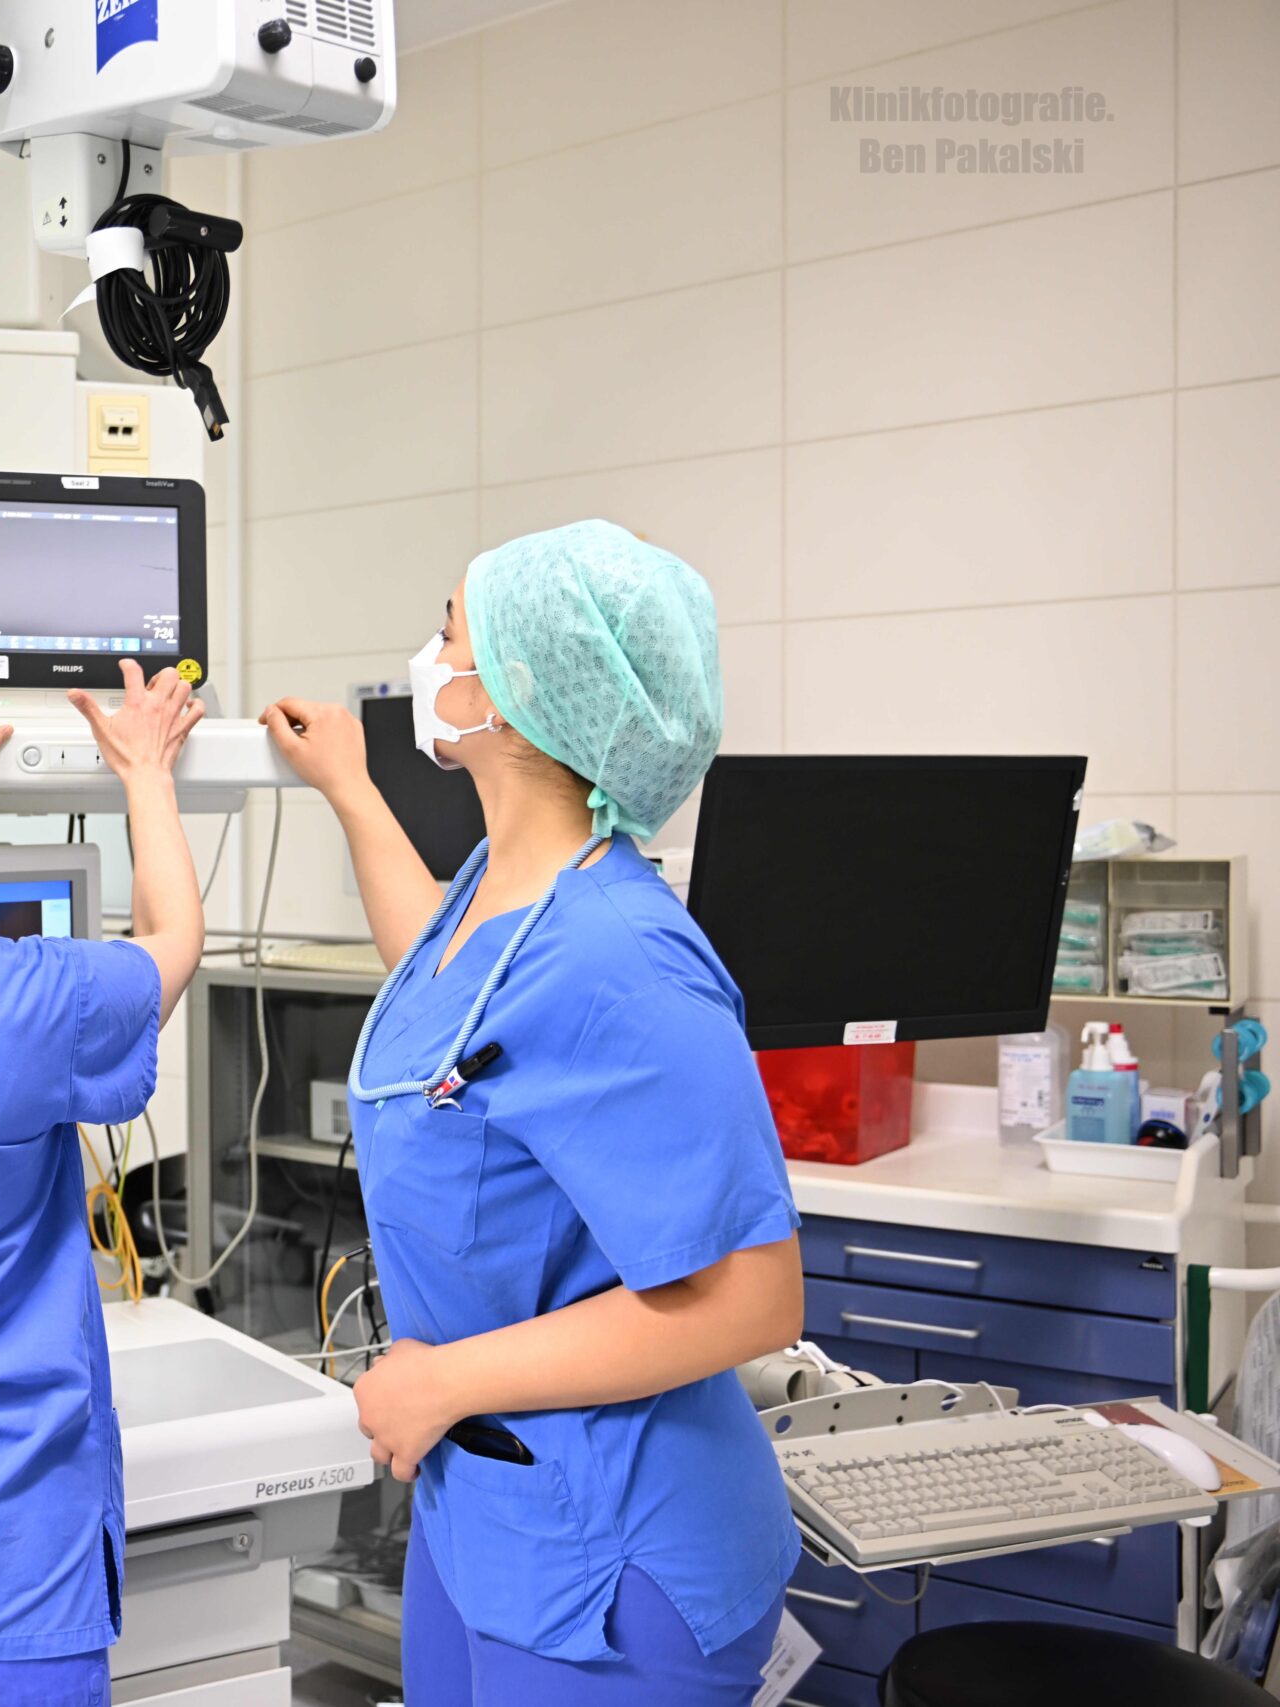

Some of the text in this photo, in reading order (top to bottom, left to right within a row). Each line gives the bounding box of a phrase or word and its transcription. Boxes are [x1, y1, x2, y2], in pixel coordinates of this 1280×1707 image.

[52, 665, 84, 673] PHILIPS
[255, 1466, 355, 1499] Perseus A500
